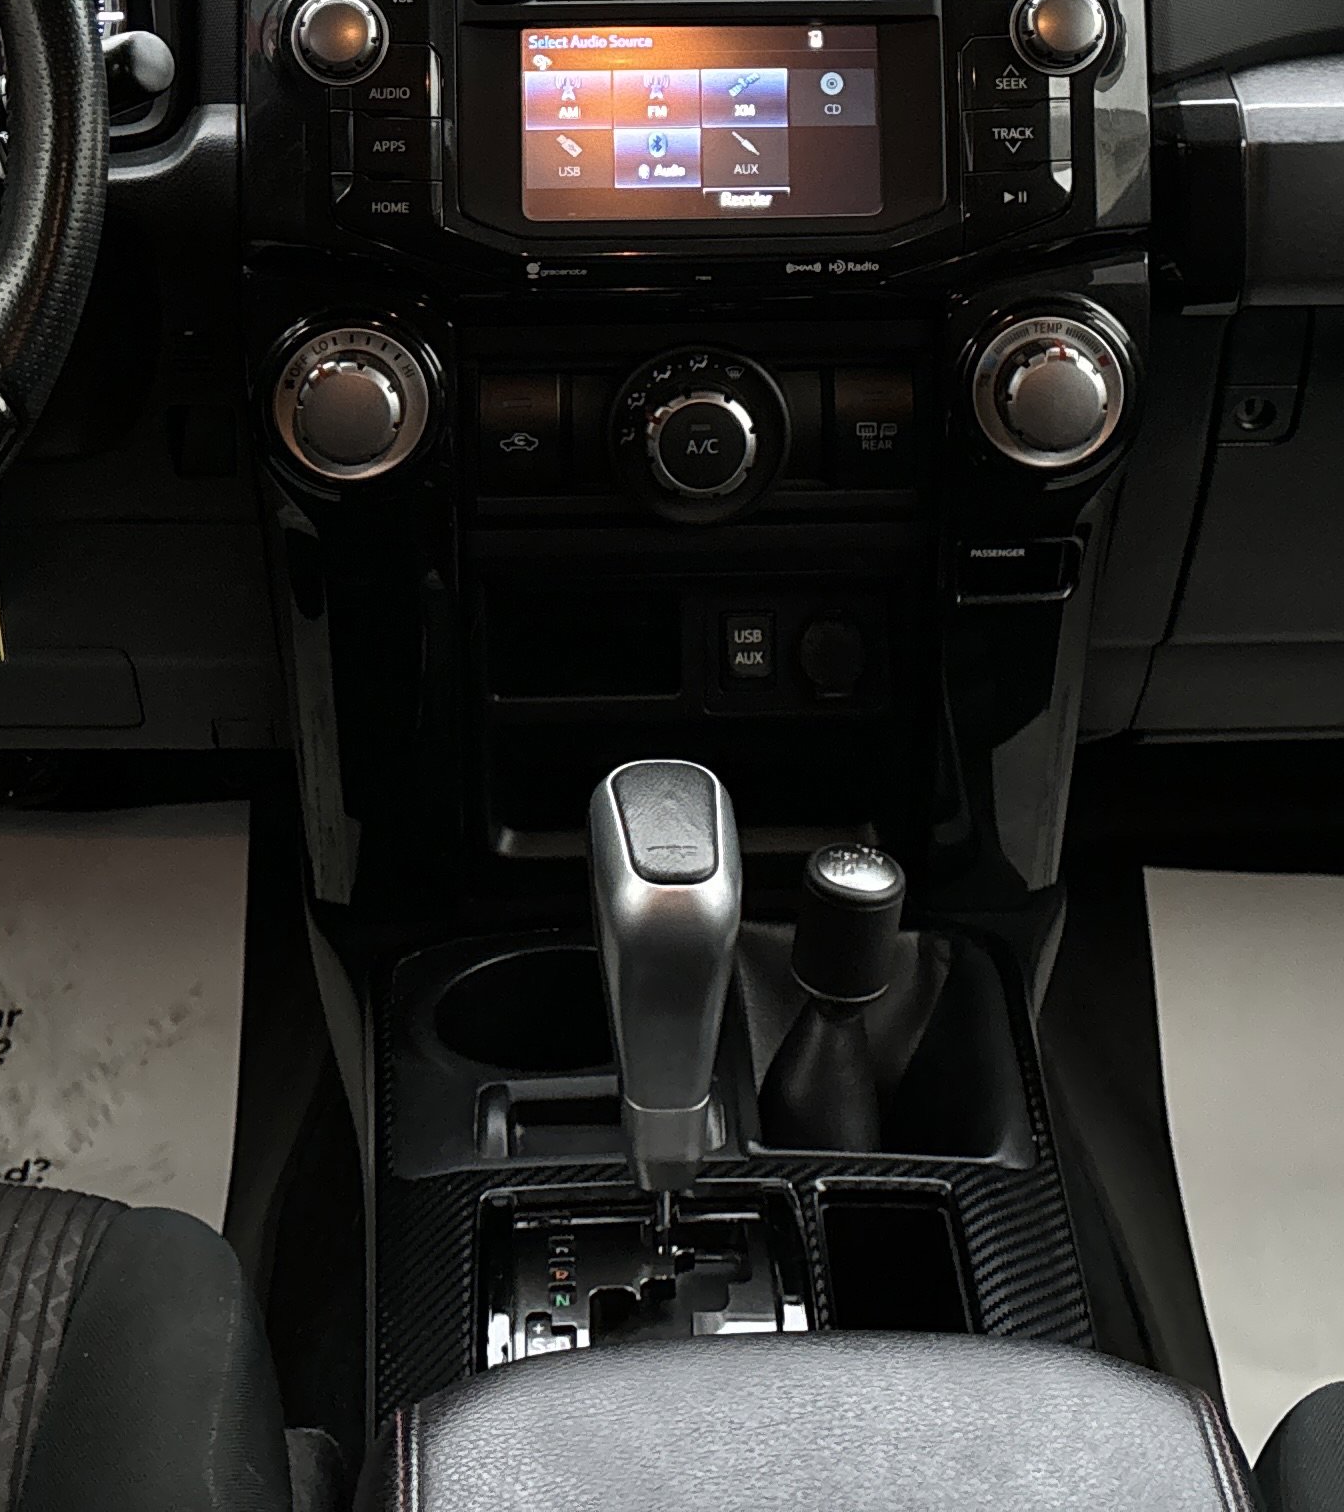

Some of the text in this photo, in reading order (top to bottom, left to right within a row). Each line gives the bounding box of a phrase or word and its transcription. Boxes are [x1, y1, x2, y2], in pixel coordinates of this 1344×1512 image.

[528, 35, 653, 49] Select Audio Source
[995, 77, 1028, 89] SEEK
[368, 87, 410, 100] AUDIO
[558, 104, 581, 119] AM
[647, 104, 668, 119] FM
[824, 103, 842, 116] CD
[991, 127, 1034, 139] TRACK
[372, 140, 406, 153] APPS
[558, 164, 581, 177] USB
[733, 163, 760, 176] AUX
[371, 201, 410, 214] HOME
[847, 261, 879, 272] Radio
[1033, 322, 1063, 335] TEMP
[312, 340, 329, 356] LO
[290, 354, 309, 378] OFF
[686, 438, 719, 455] A/C
[861, 439, 893, 451] REAR
[970, 548, 1026, 558] PASSENGER
[734, 630, 763, 644] USB
[734, 651, 764, 665] AUX
[555, 1294, 571, 1306] N
